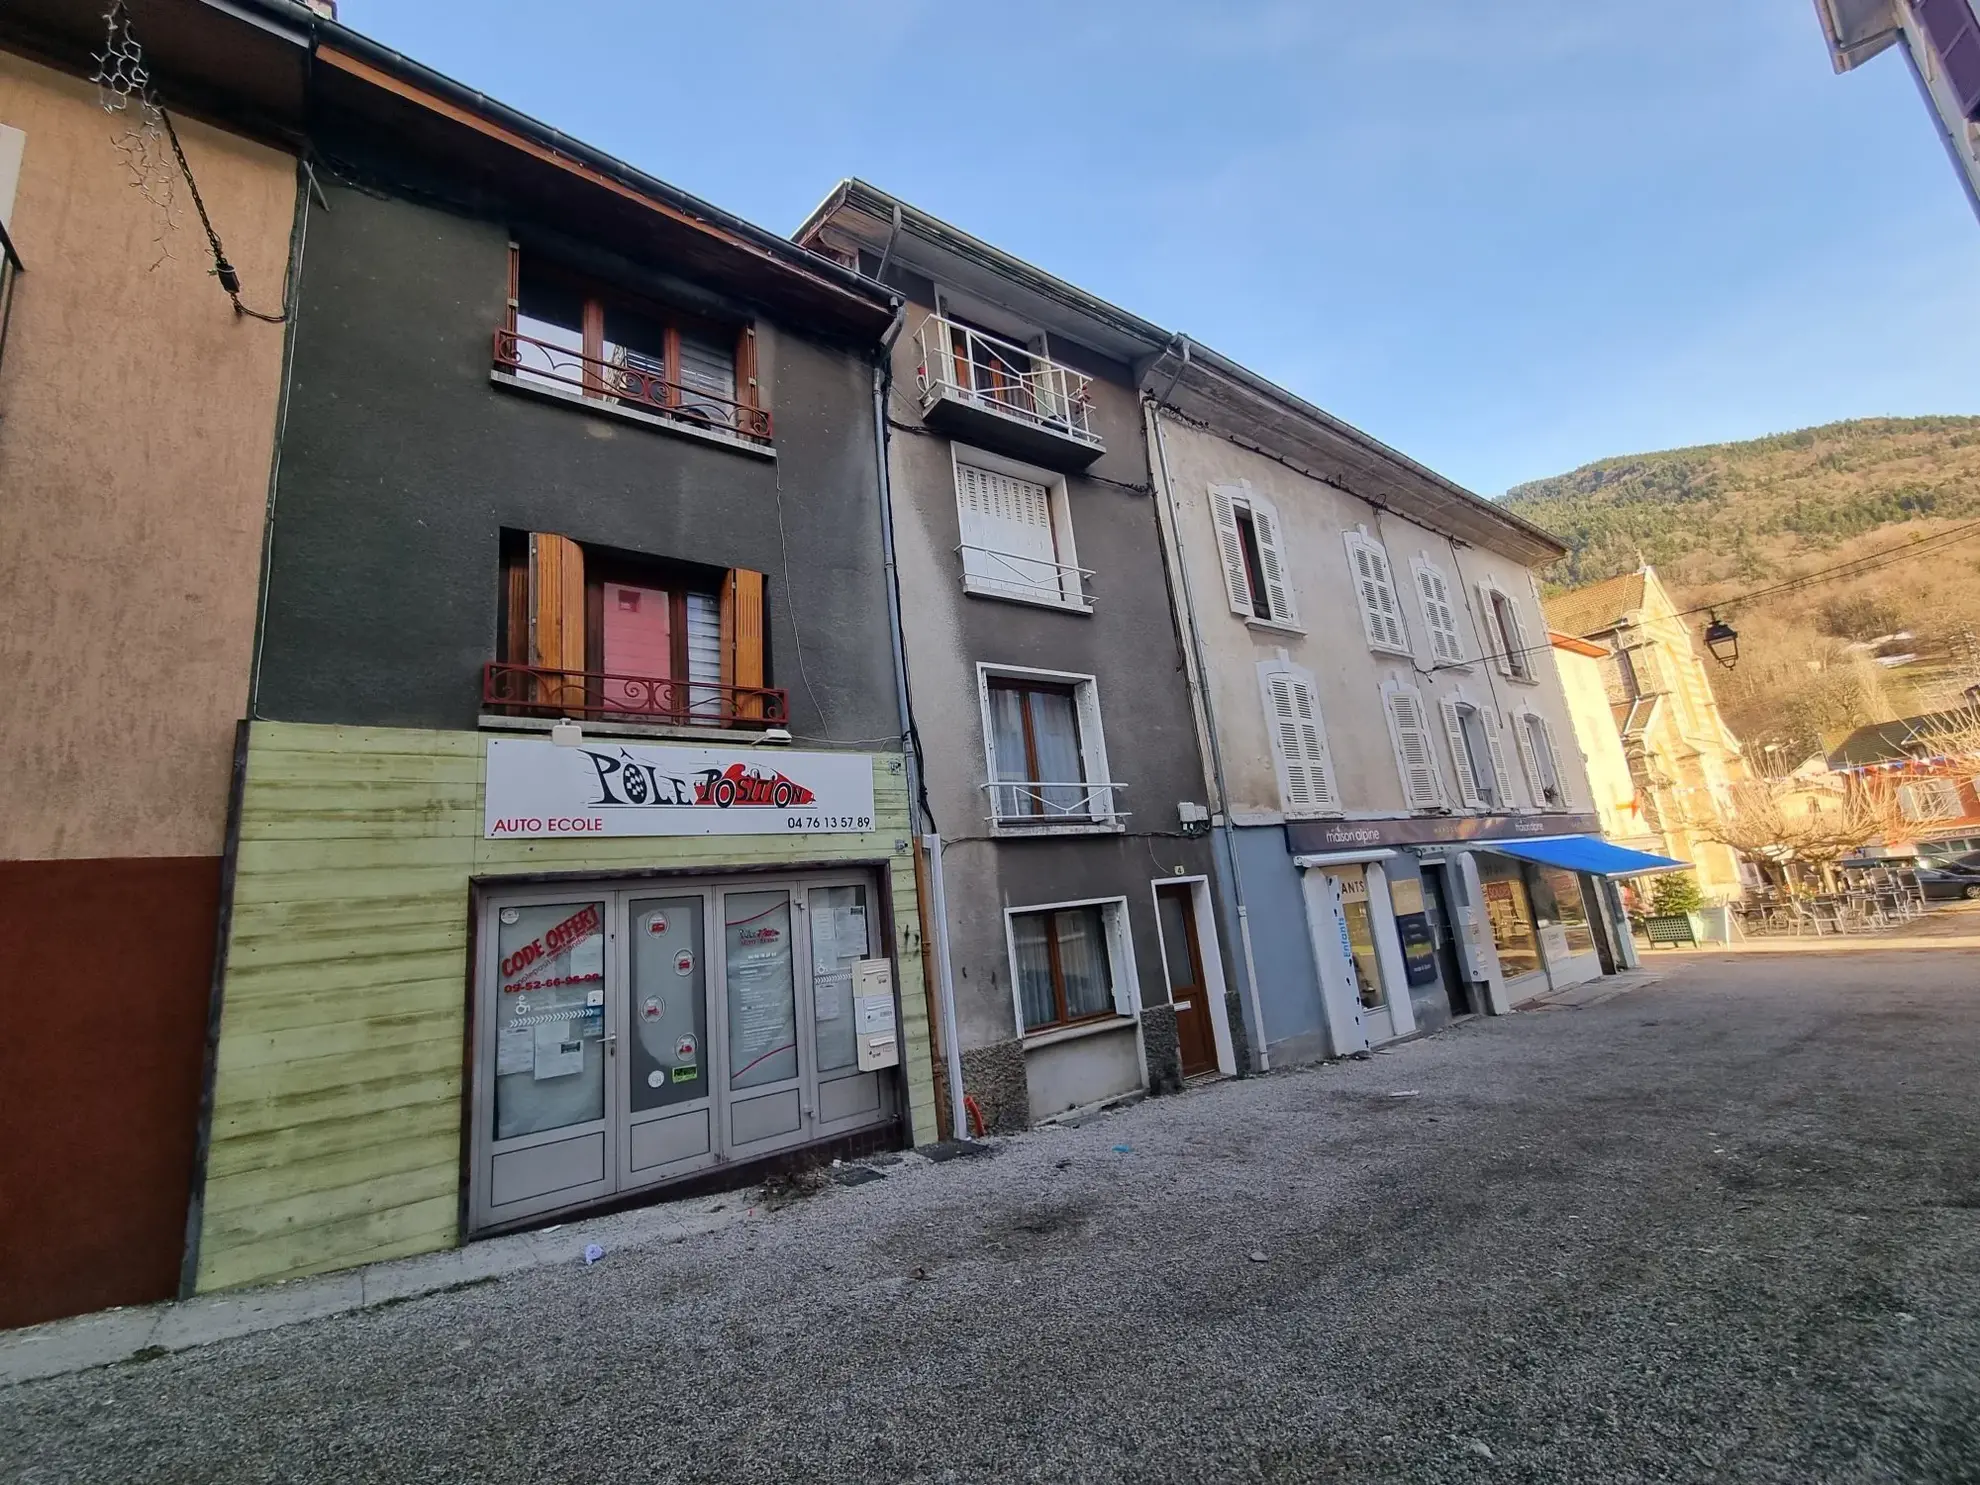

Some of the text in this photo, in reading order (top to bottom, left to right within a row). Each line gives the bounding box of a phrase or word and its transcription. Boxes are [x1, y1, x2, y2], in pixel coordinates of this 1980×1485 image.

[493, 818, 603, 832] AUTO ECOLE
[787, 816, 870, 829] 04 76 13 57 89
[1326, 828, 1380, 844] maison alpine
[1341, 880, 1365, 895] ANTS
[502, 937, 545, 978] CODE
[545, 903, 599, 949] OFFERT
[1339, 917, 1351, 958] Enfants
